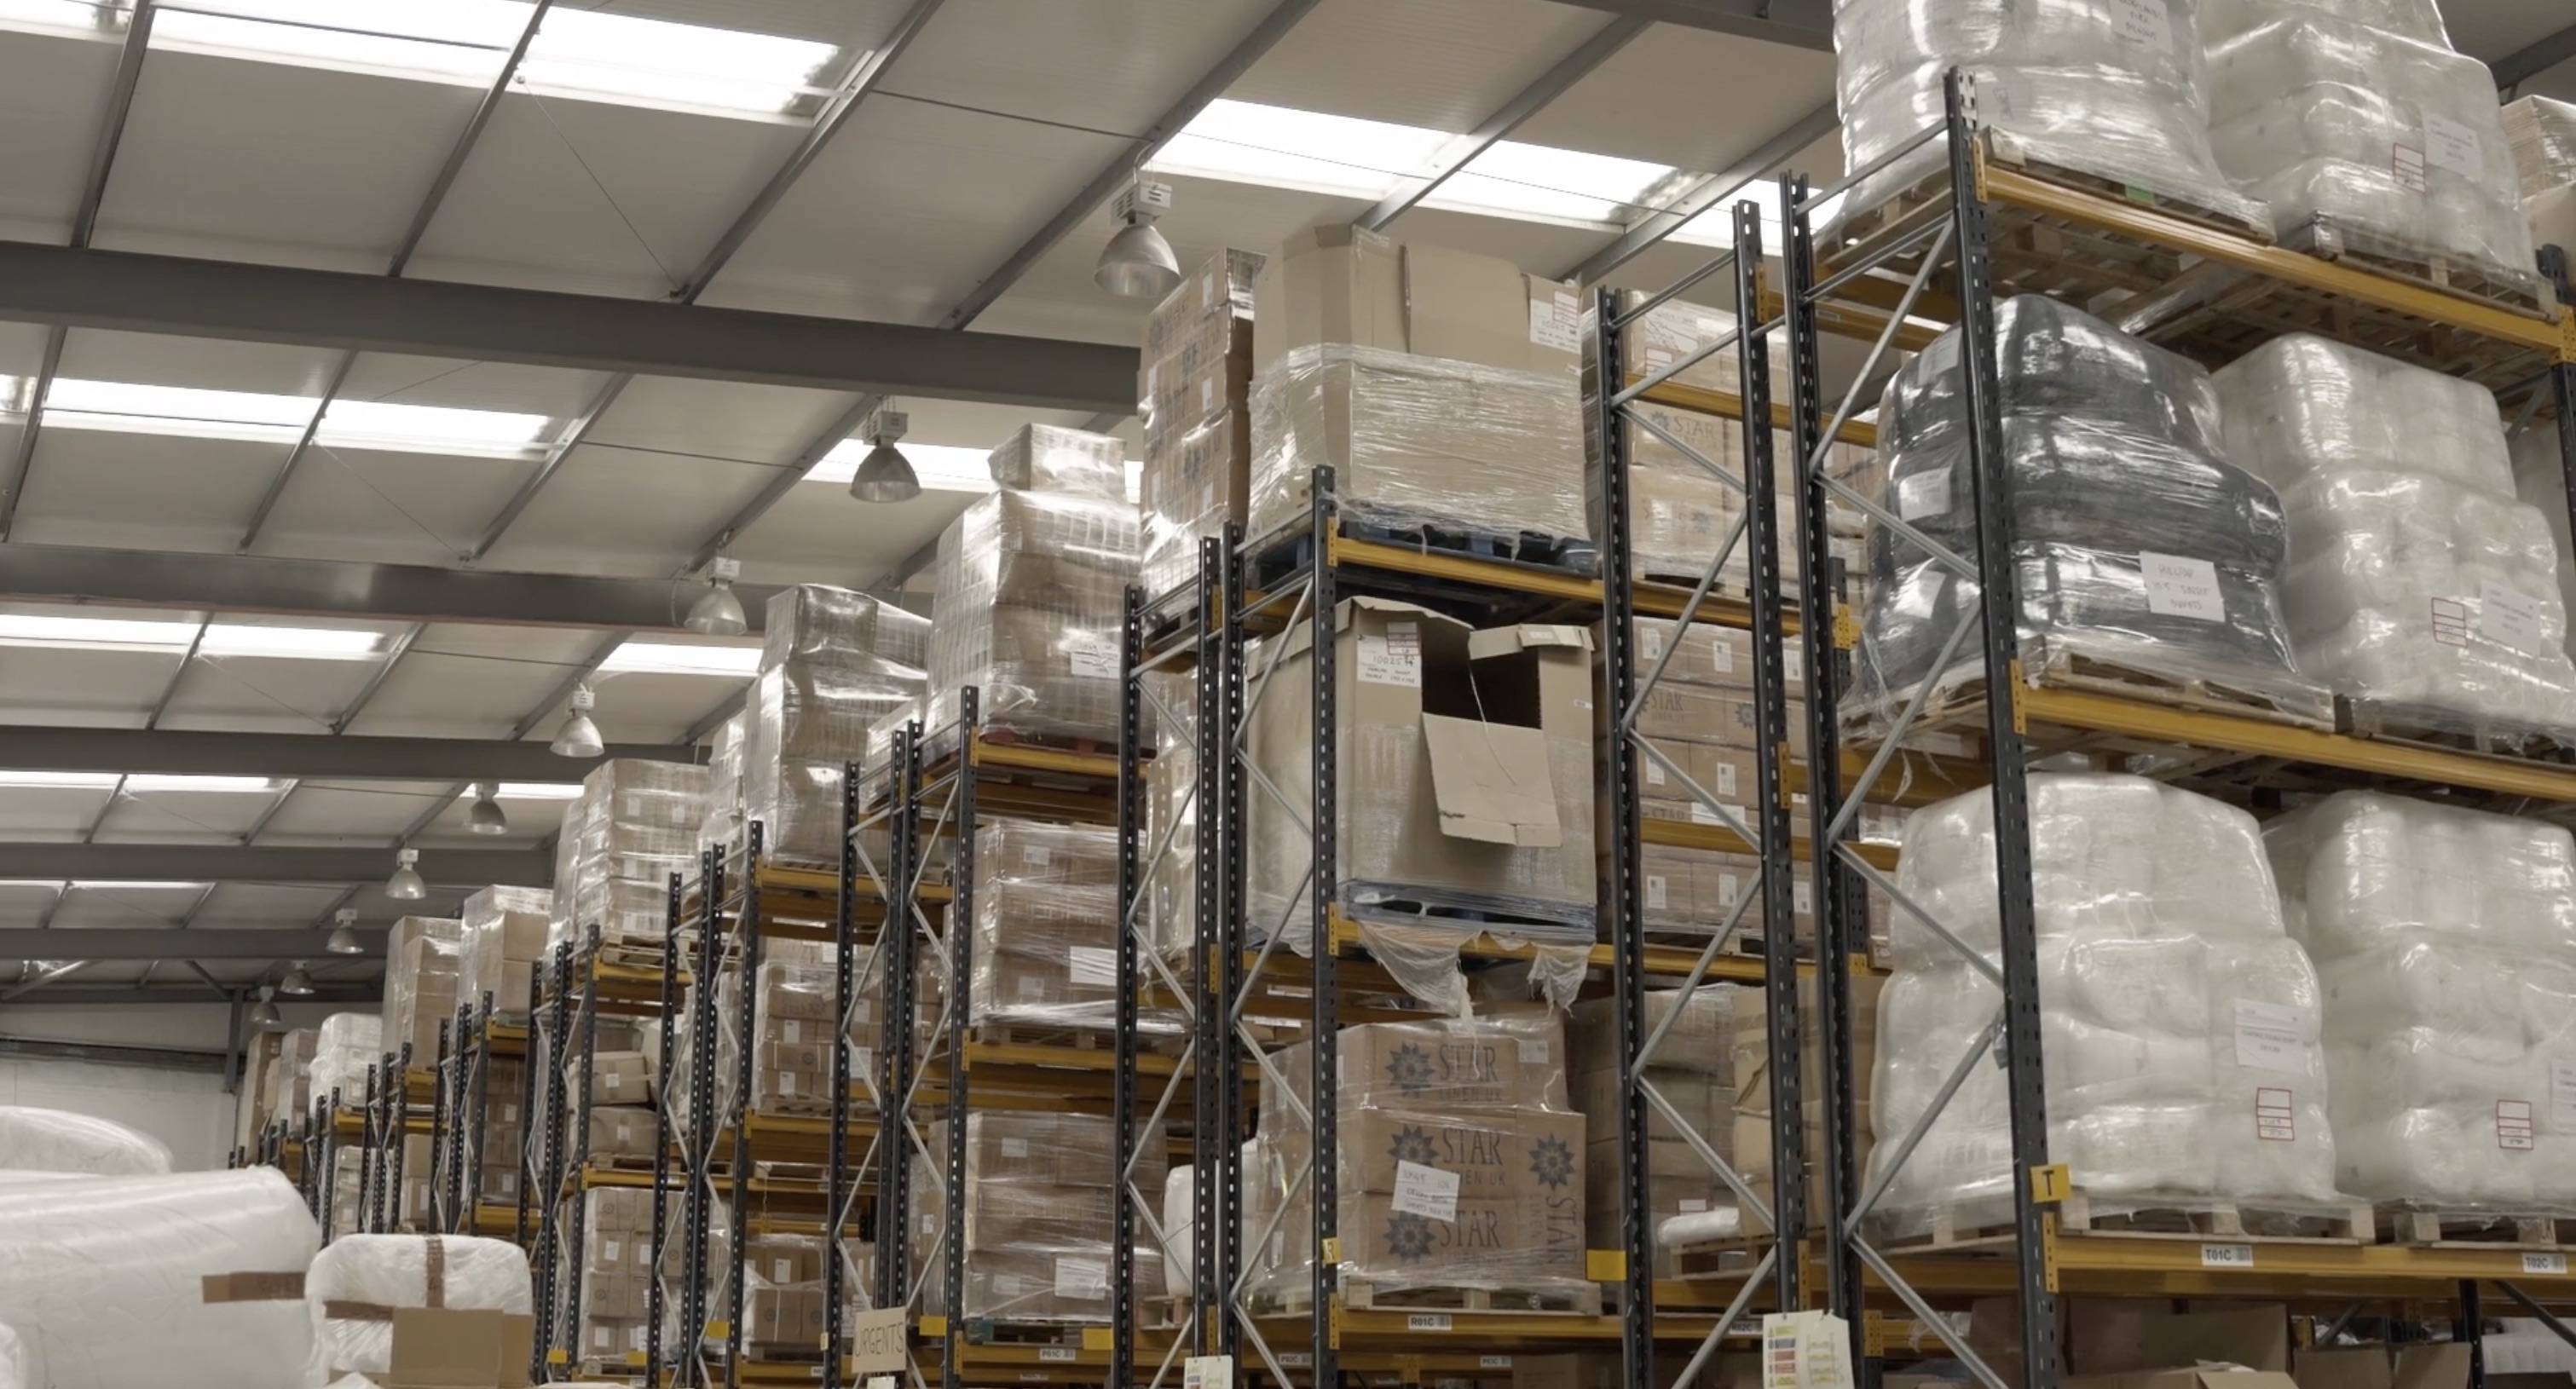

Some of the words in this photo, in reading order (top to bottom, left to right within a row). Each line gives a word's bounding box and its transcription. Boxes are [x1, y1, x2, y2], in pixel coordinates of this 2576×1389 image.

[1673, 416, 1716, 440] STAR
[1651, 690, 1684, 712] STAR
[1440, 1044, 1499, 1082] STAR
[1442, 1127, 1504, 1166] STAR
[1489, 1171, 1506, 1186] UK
[2042, 1169, 2054, 1196] T
[1439, 1209, 1501, 1248] STAR
[1545, 1195, 1577, 1265] STAR
[1327, 1242, 1336, 1262] R
[2205, 1248, 2232, 1261] T01C
[1410, 1317, 1435, 1328] R01C
[854, 1322, 904, 1357] URGENTS
